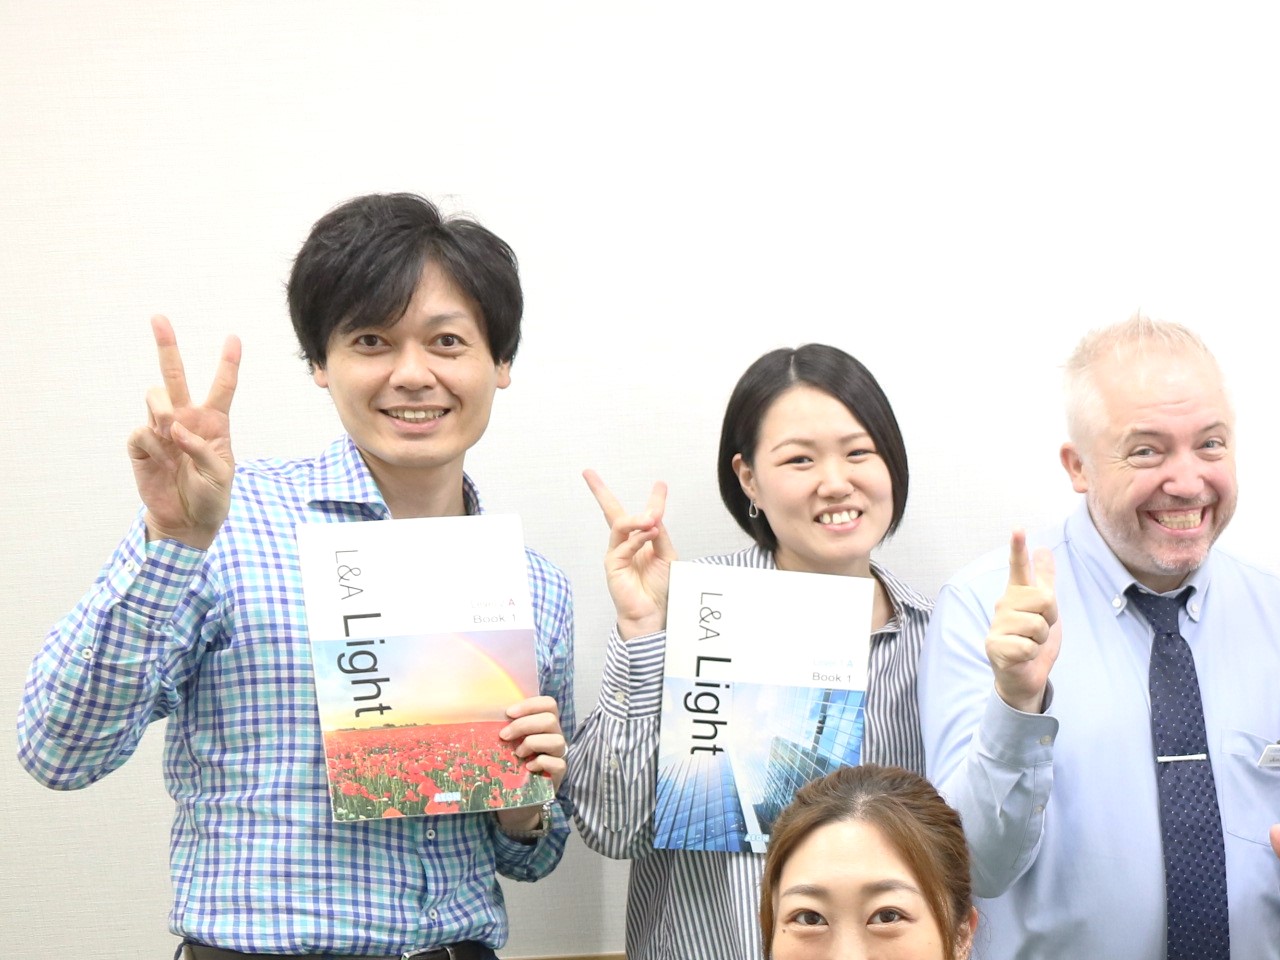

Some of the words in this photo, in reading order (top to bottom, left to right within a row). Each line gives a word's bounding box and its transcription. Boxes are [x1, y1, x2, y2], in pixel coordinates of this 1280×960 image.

[335, 549, 364, 600] L&A
[473, 614, 506, 623] Book
[698, 591, 723, 641] L&A
[337, 613, 393, 718] Light
[812, 672, 842, 682] Book
[683, 655, 732, 756] Light
